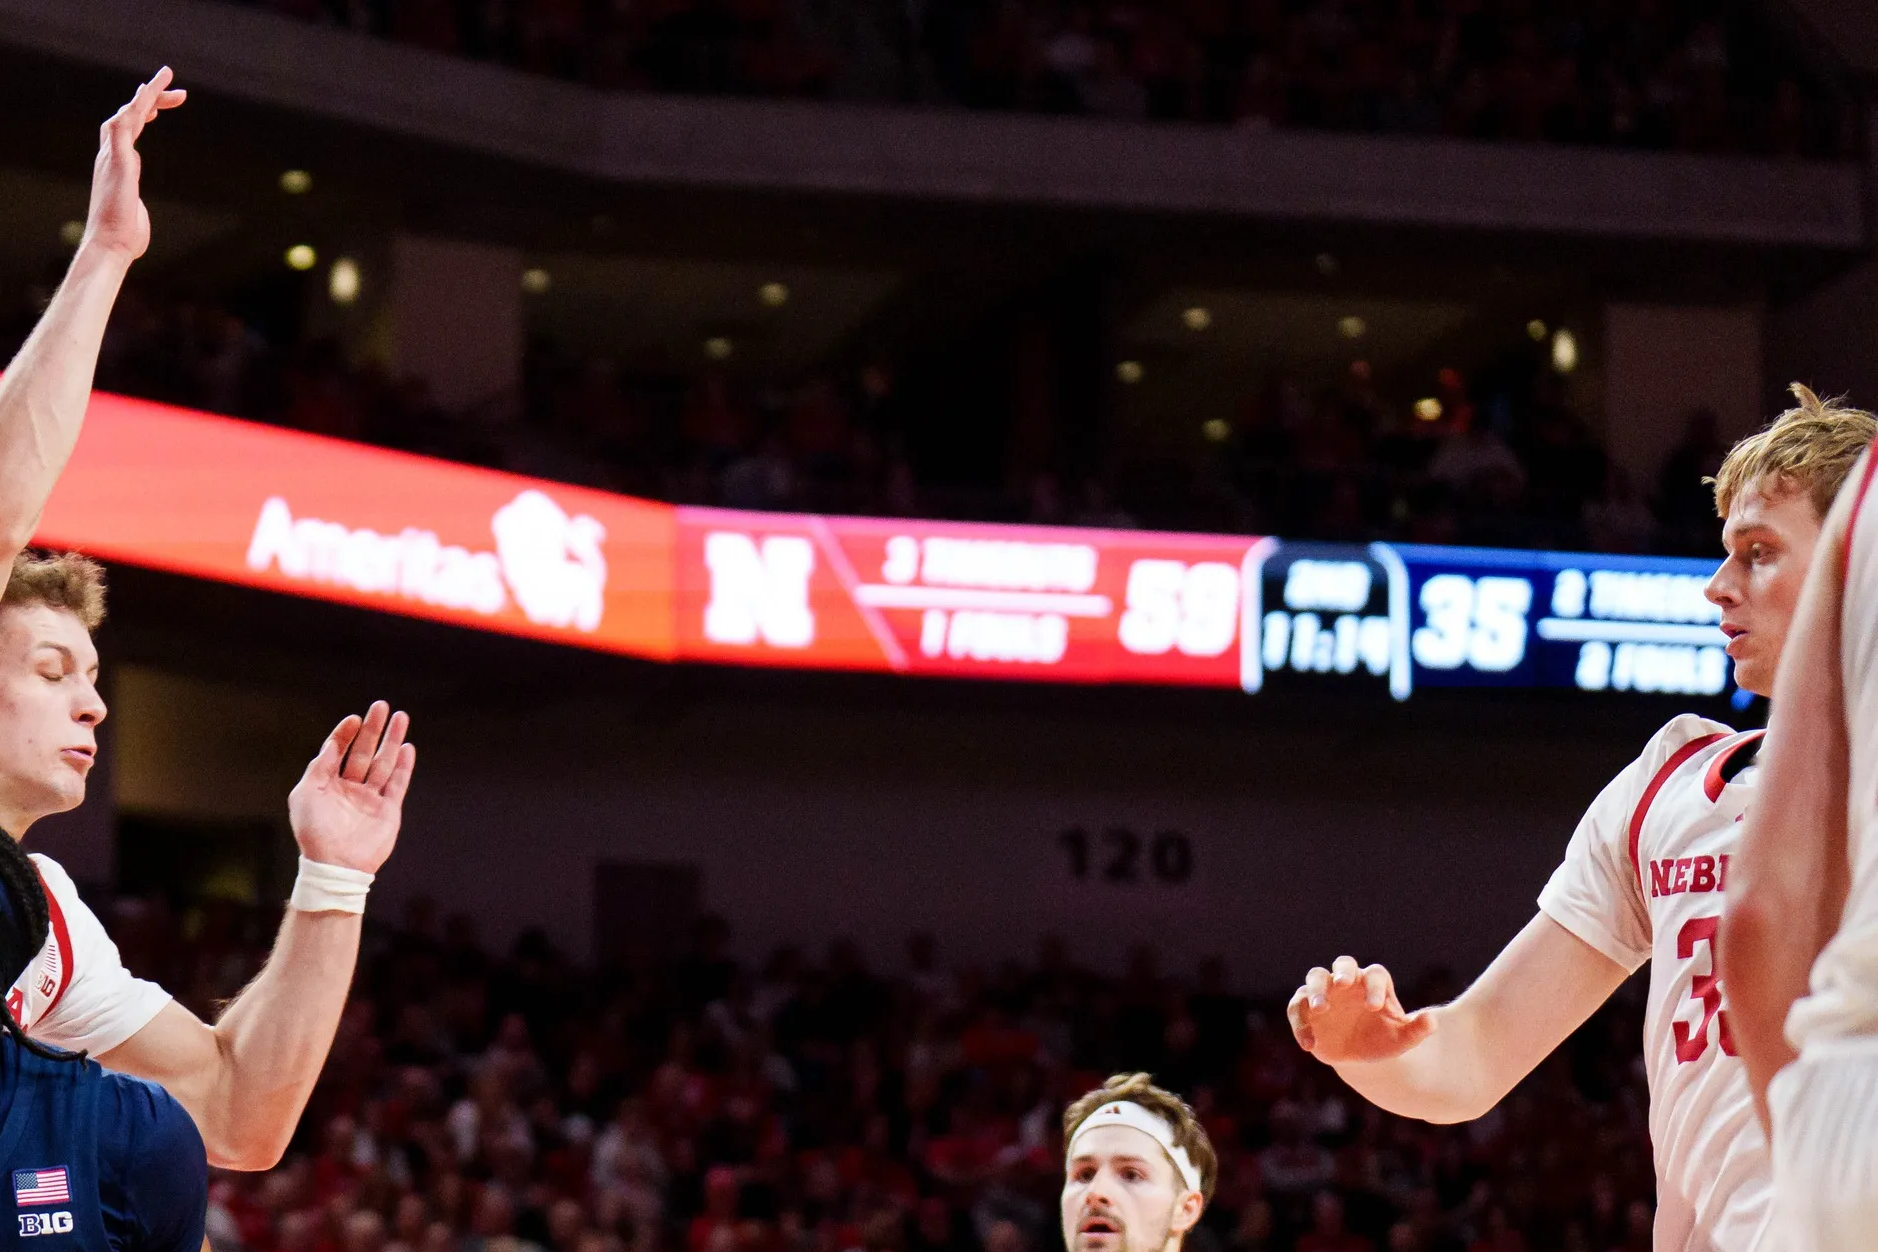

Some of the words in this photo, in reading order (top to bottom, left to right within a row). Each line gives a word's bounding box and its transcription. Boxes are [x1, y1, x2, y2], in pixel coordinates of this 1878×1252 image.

[246, 496, 505, 614] Ameritas
[703, 531, 816, 649] N
[1117, 557, 1240, 657] 59
[1411, 573, 1533, 673] 35
[1058, 826, 1194, 884] 120
[1673, 915, 1740, 1065] 3
